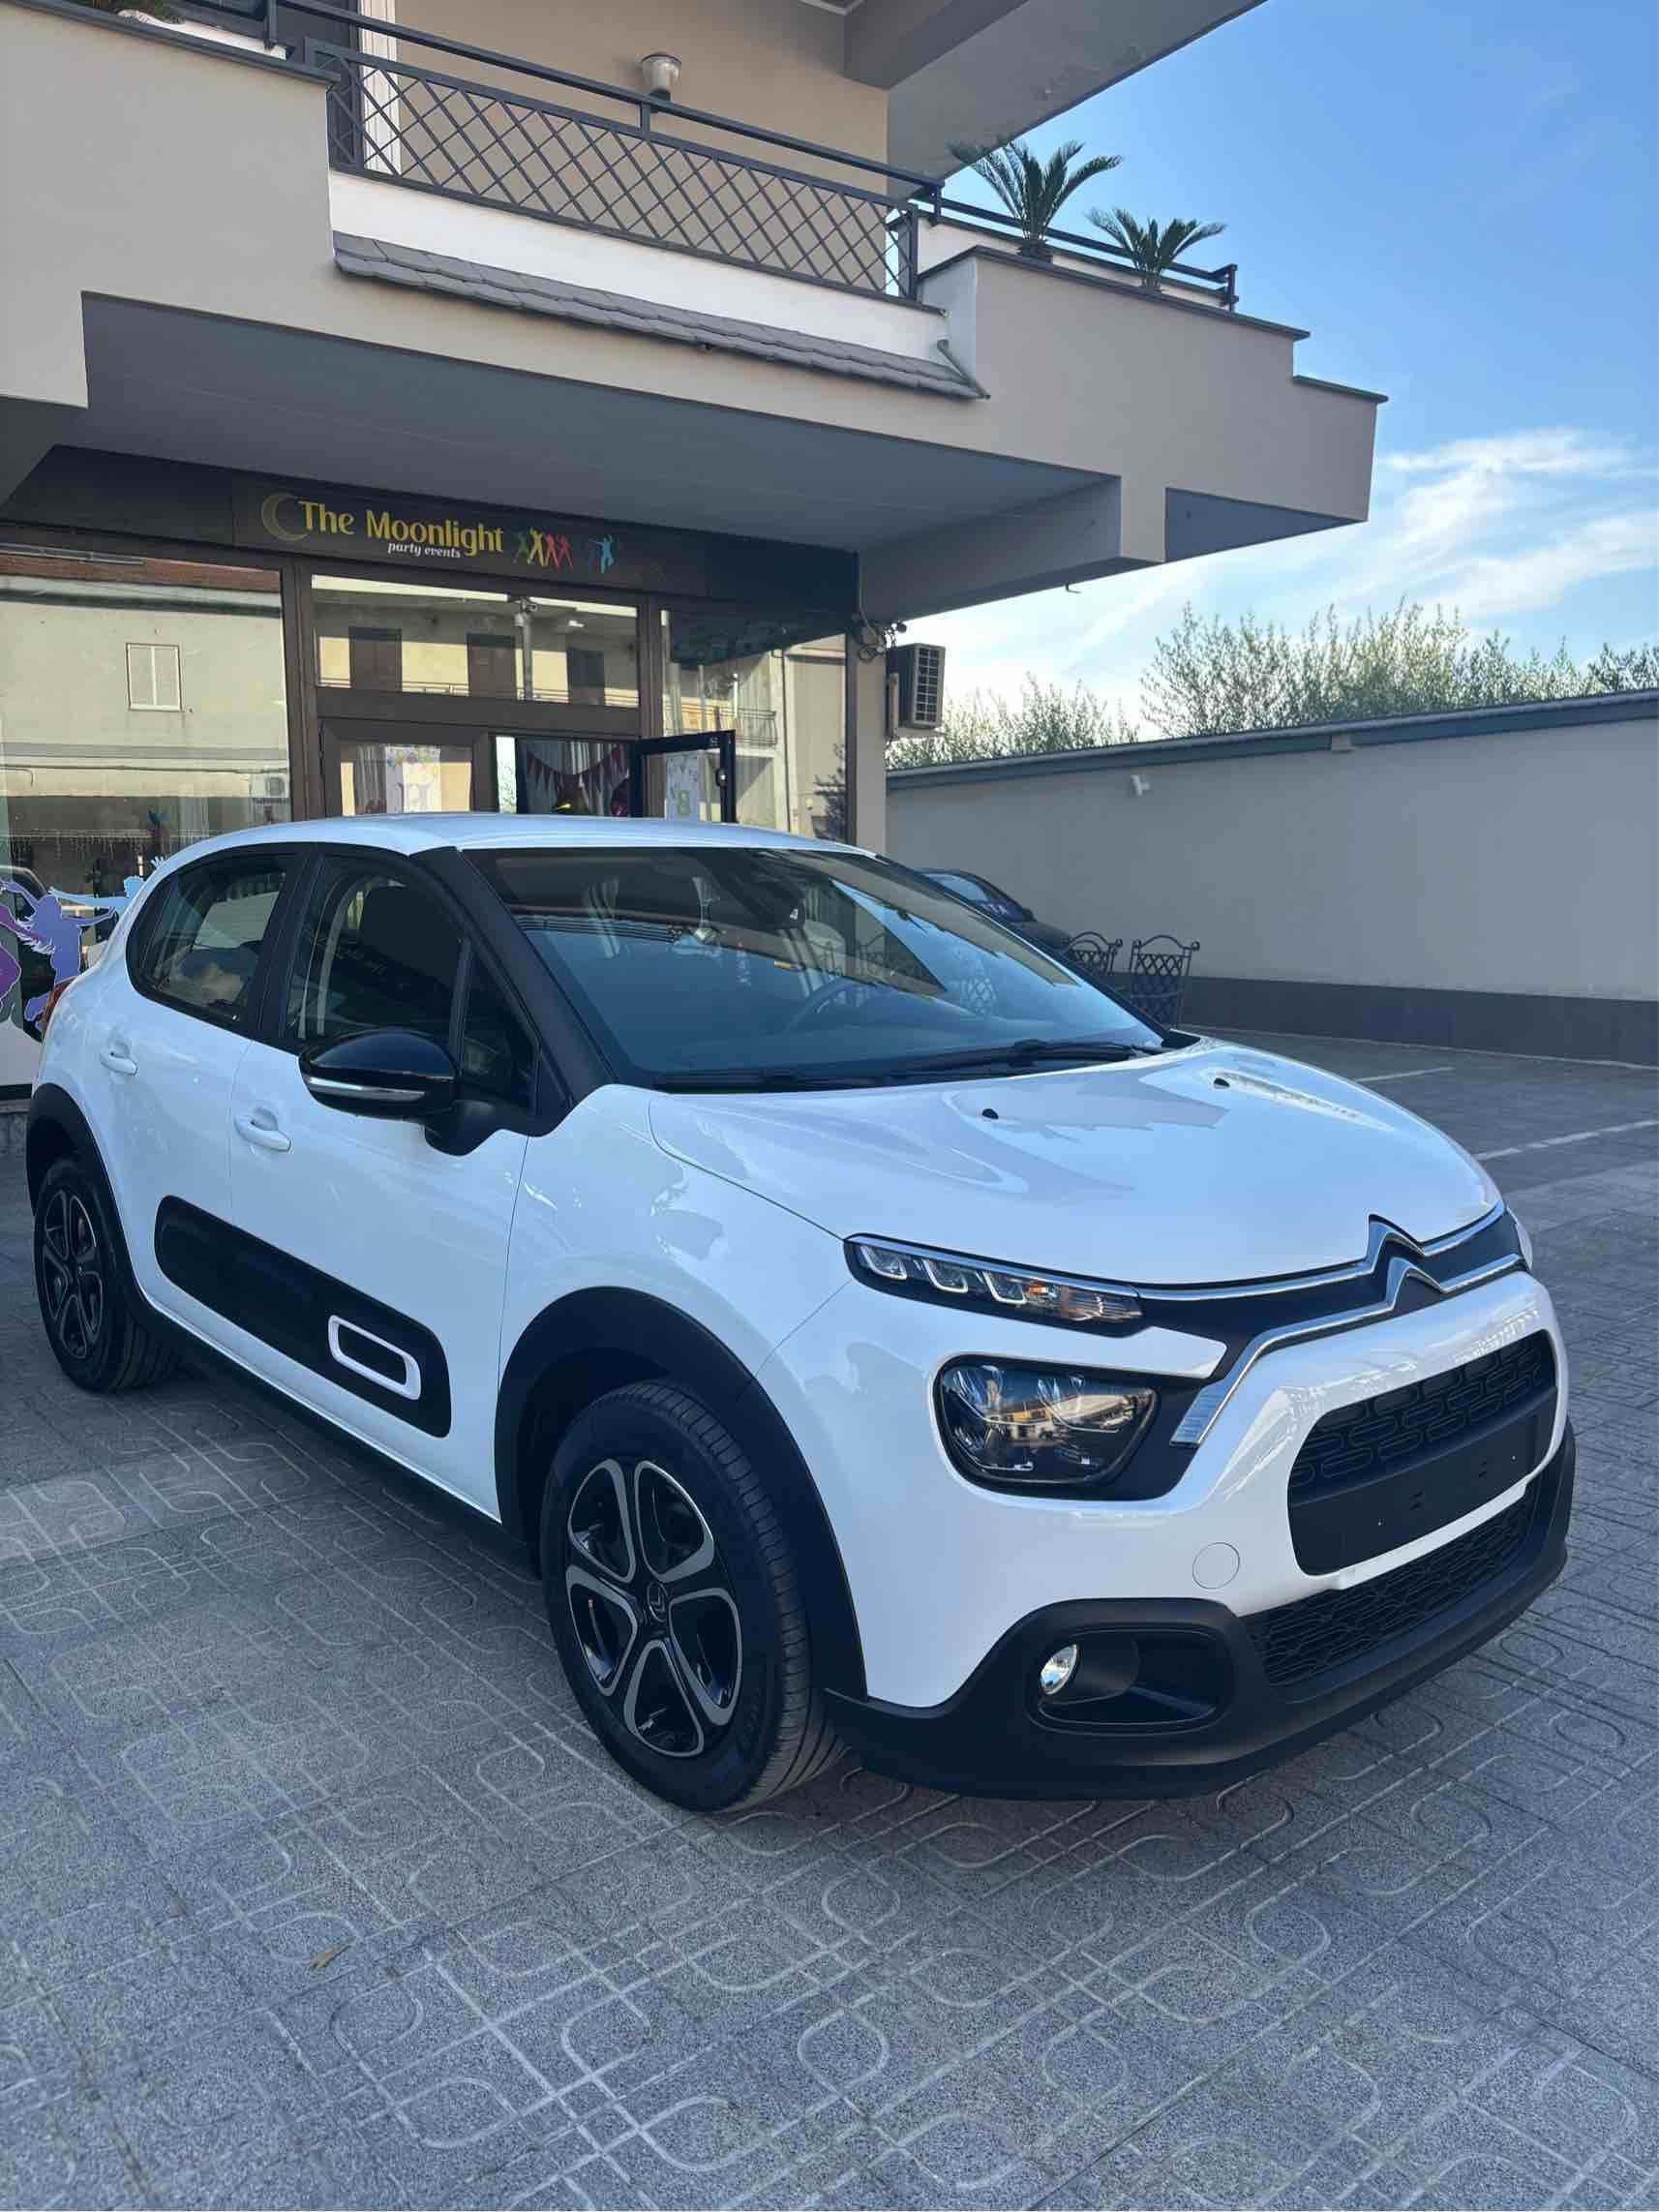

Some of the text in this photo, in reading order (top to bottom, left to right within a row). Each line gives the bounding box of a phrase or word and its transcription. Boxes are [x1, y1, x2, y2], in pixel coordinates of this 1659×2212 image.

[297, 500, 503, 556] The Moonlight
[387, 542, 462, 559] party events
